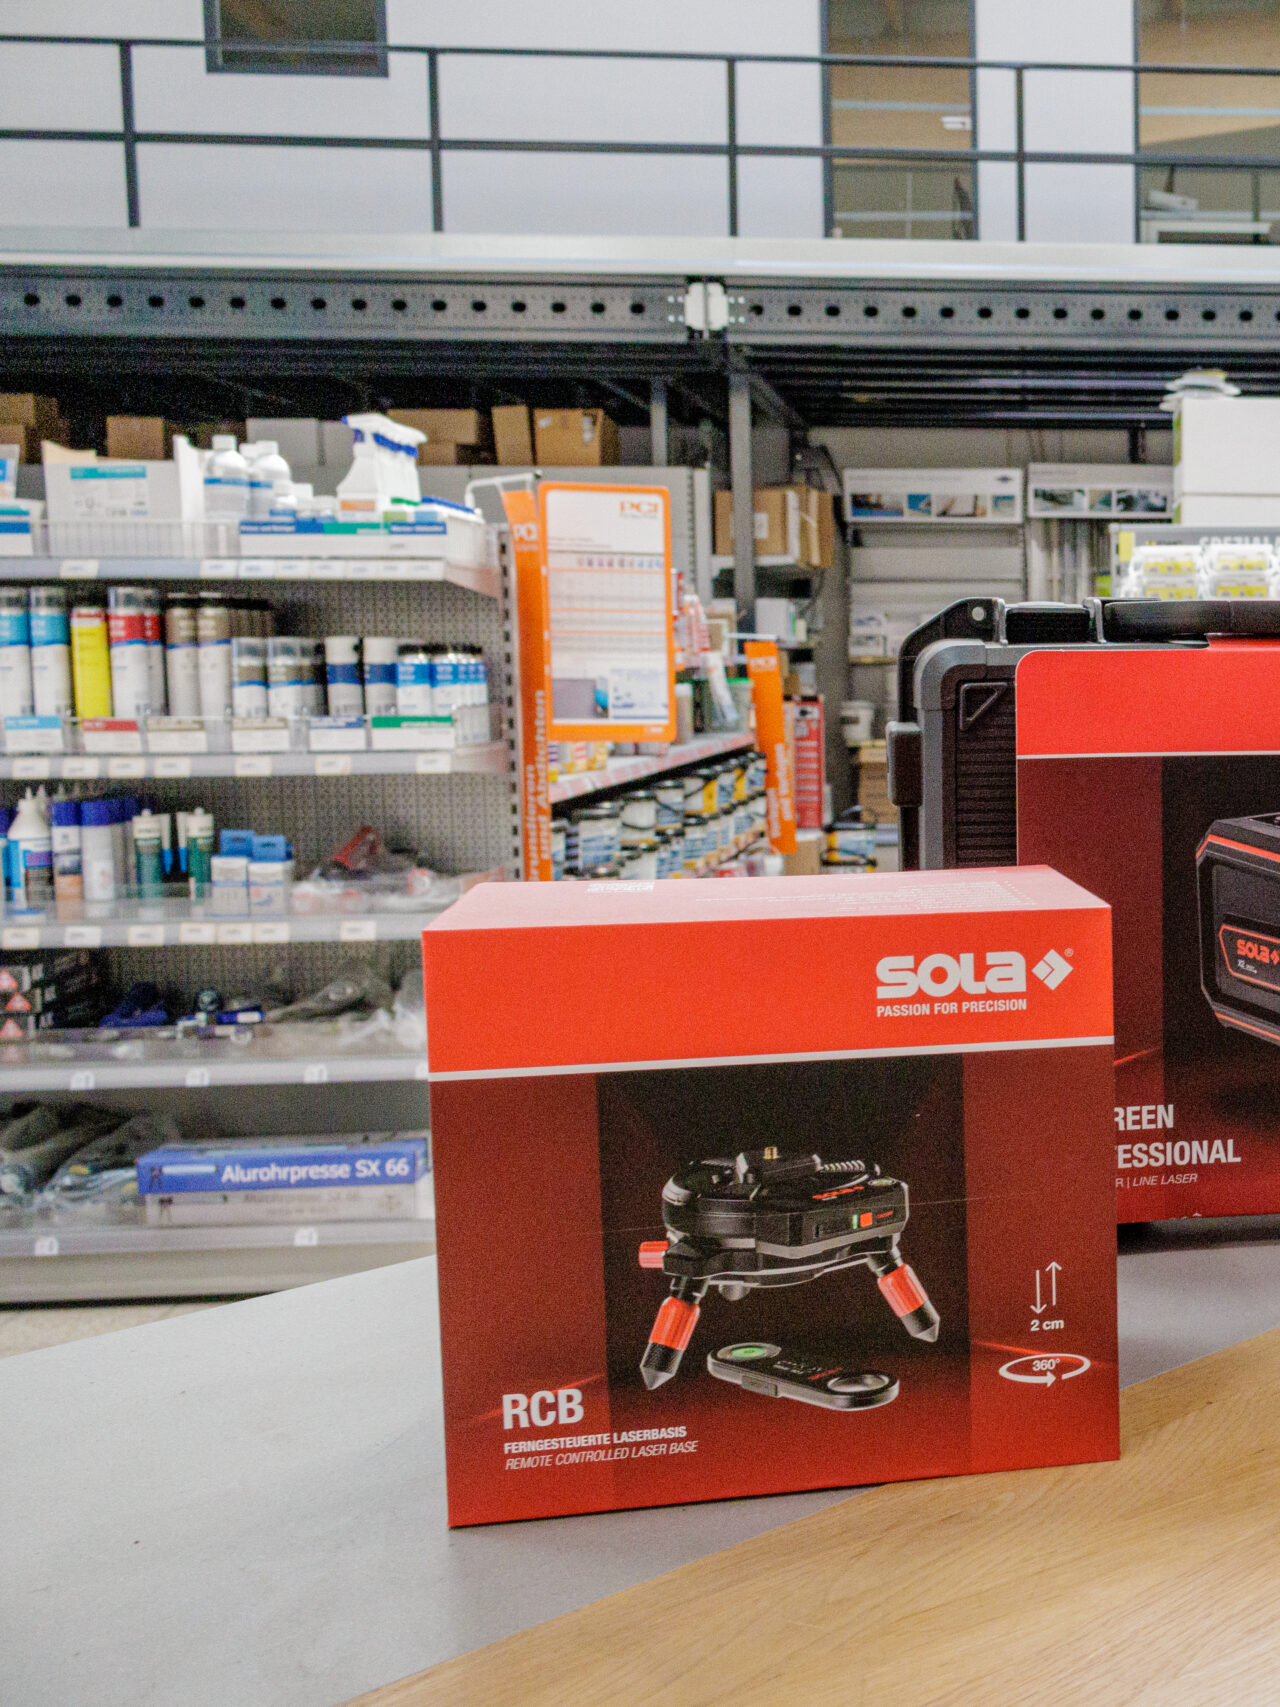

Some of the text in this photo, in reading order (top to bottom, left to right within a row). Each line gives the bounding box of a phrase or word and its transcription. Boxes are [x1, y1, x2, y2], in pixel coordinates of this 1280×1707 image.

[877, 999, 1027, 1018] PASSION FOR PRECISION
[1114, 1139, 1242, 1169] ESSIONAL
[221, 1158, 409, 1184] Alurohrpresse SX 66
[1133, 1175, 1158, 1187] LINE
[1161, 1173, 1198, 1185] LASER
[1030, 1319, 1065, 1332] 2 cm
[1032, 1358, 1061, 1372] 360°
[502, 1388, 584, 1430] RCB
[503, 1426, 687, 1454] FERNGESTEUERTE LASERBASIS
[505, 1440, 699, 1471] REMOTE CONTROLLED LASER BASE
